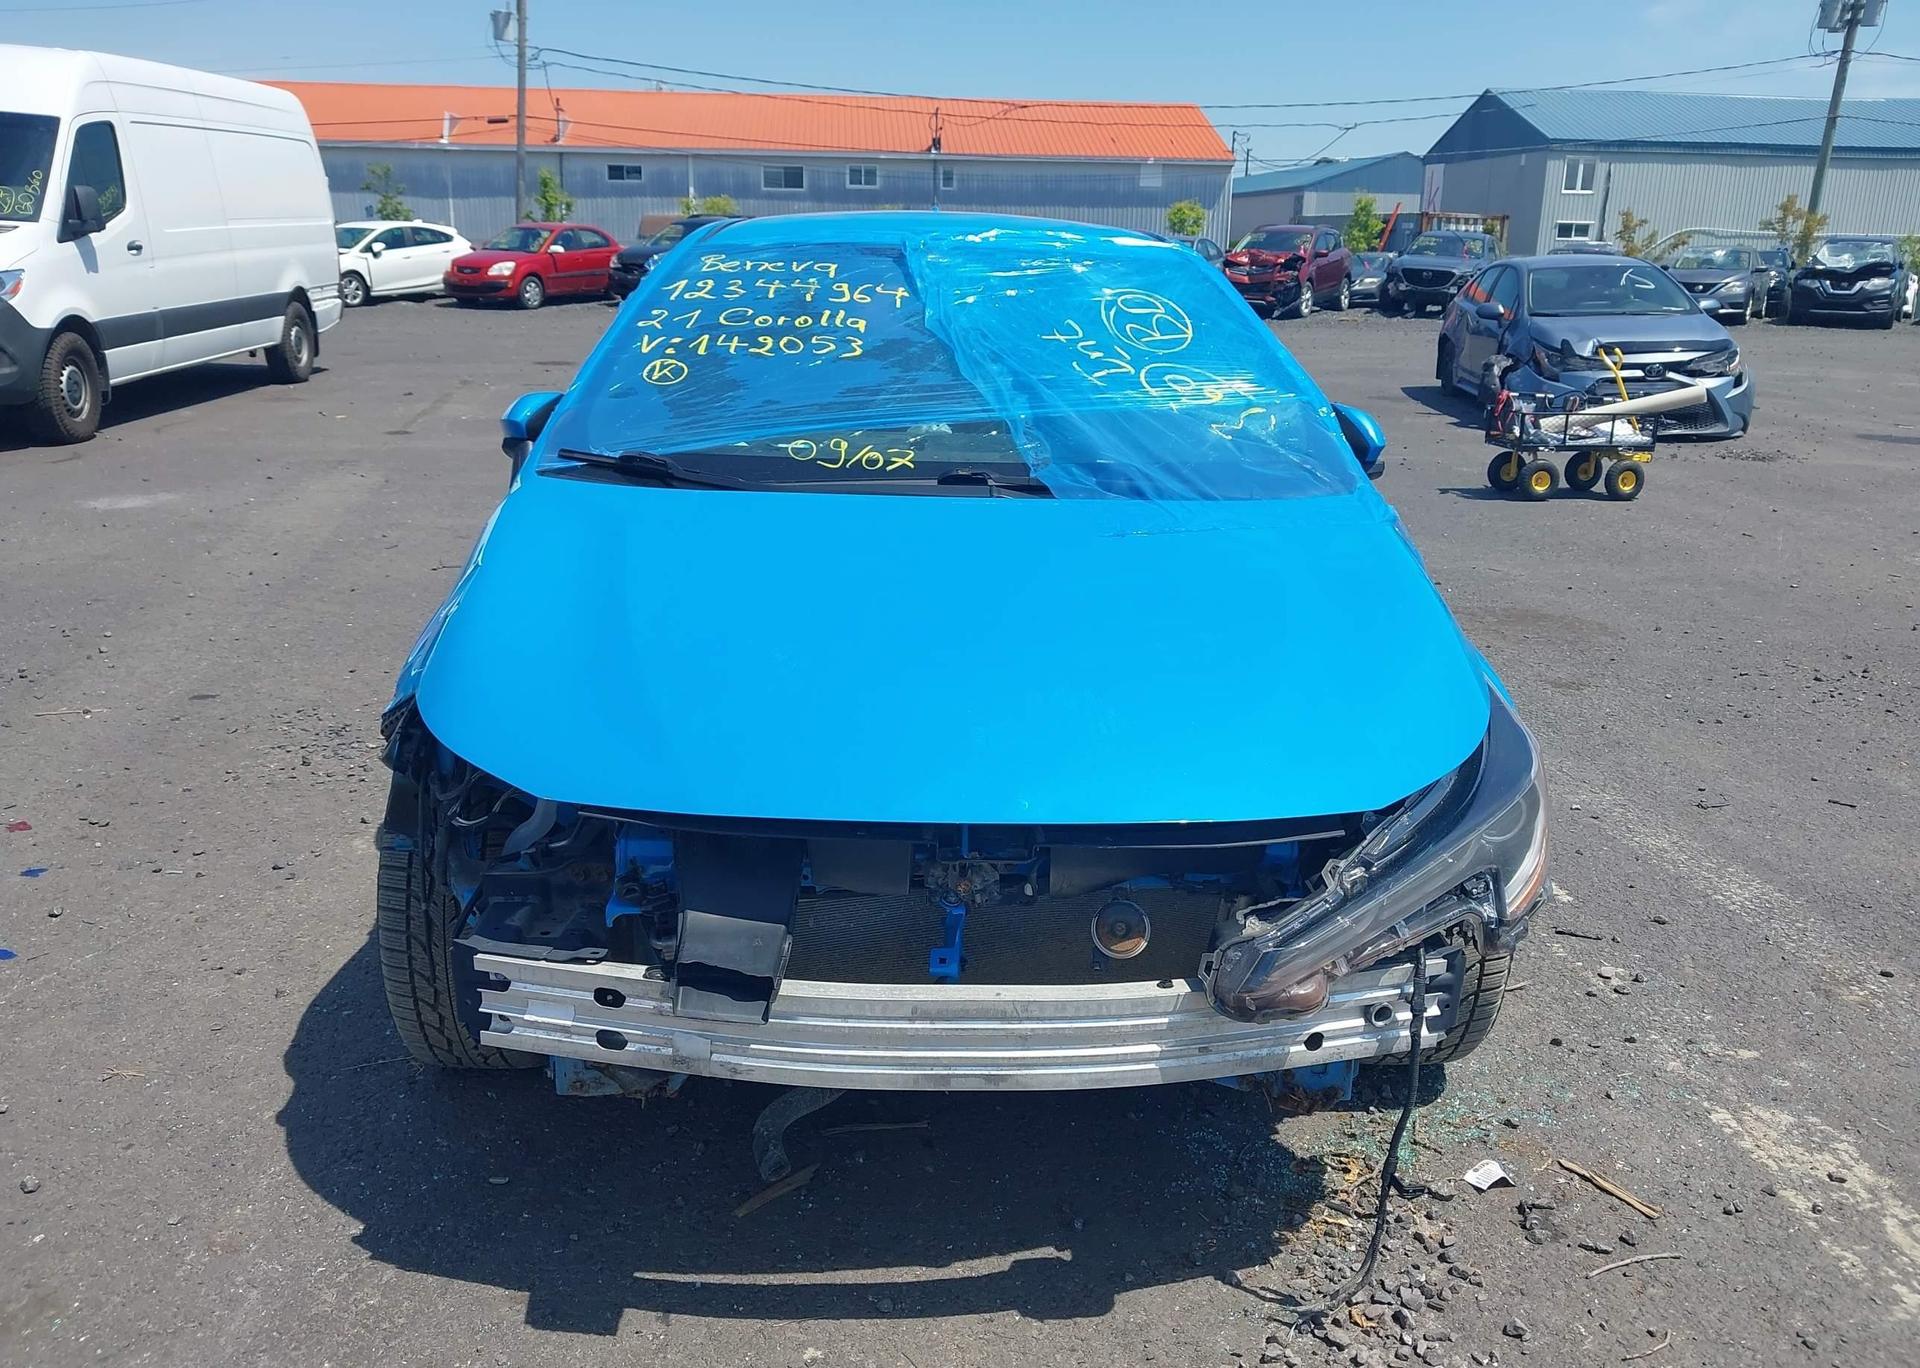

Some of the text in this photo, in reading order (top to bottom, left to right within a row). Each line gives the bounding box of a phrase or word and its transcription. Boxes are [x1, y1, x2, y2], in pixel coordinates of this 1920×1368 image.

[700, 254, 838, 278] Beneva
[636, 307, 868, 333] 21 Corolla
[788, 437, 915, 472] 09/07
